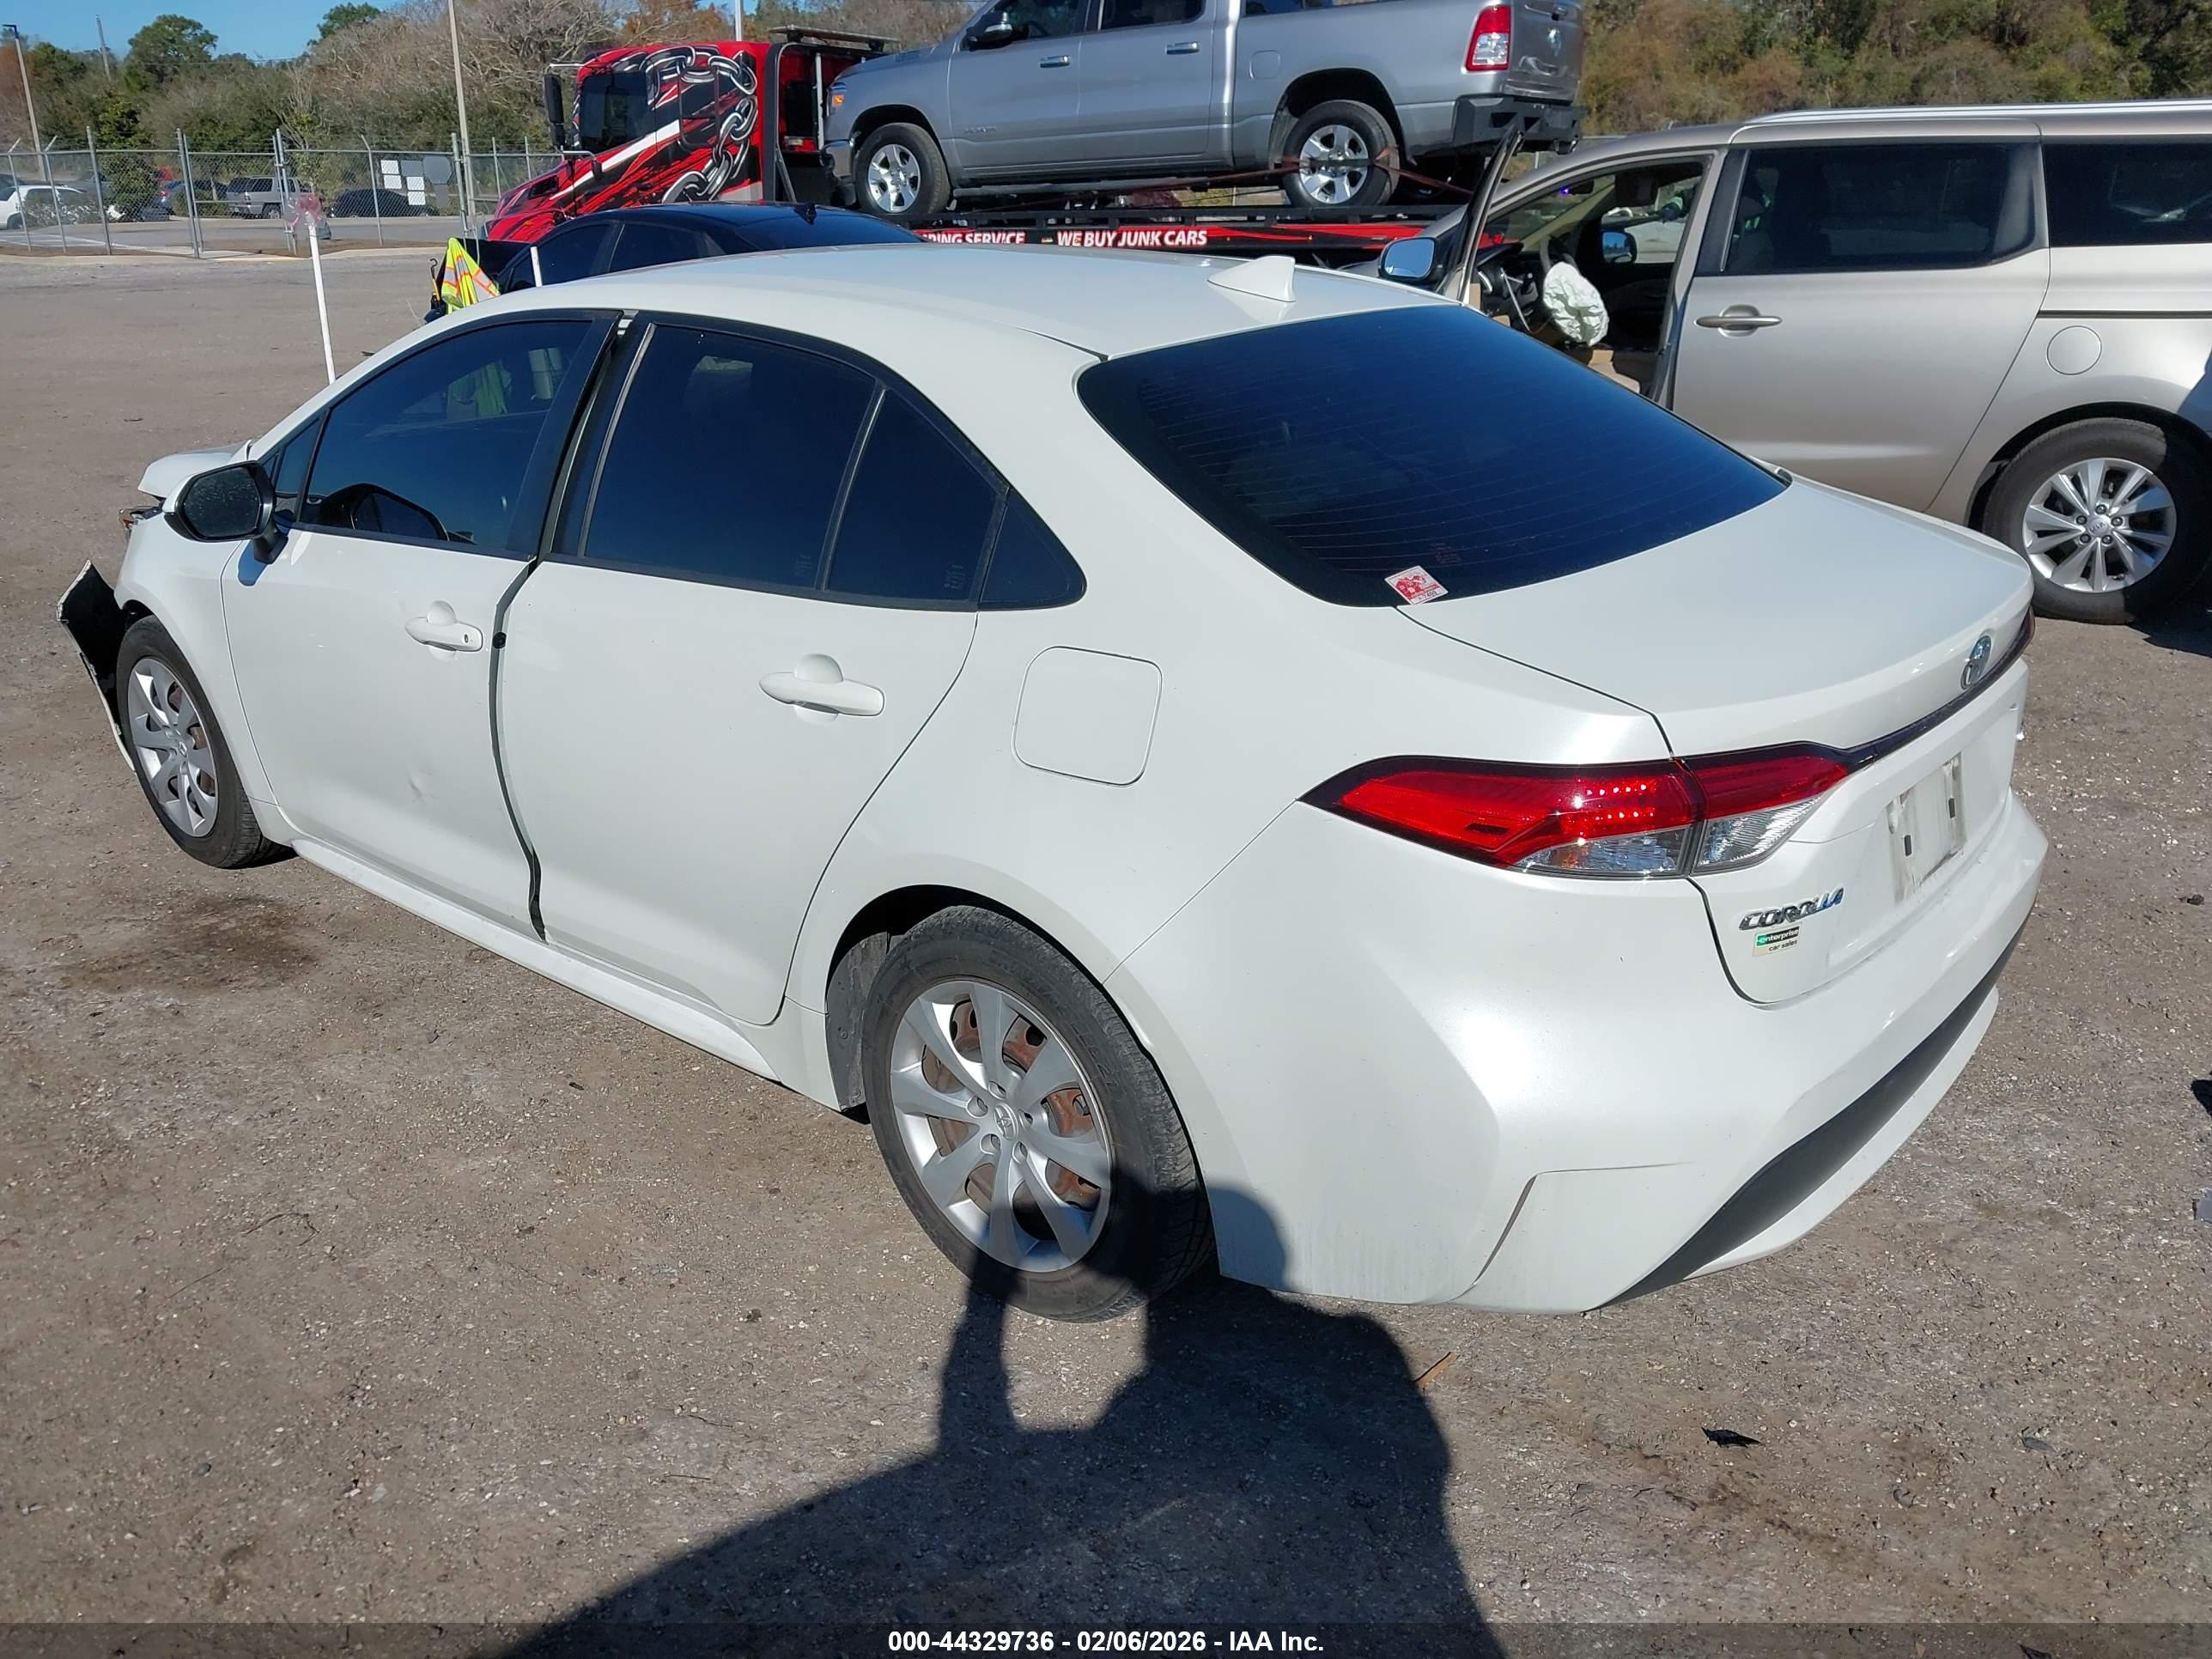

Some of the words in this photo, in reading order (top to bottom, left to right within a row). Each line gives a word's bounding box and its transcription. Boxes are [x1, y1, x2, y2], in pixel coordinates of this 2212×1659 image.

[922, 233, 963, 244] DING
[965, 232, 1025, 244] SERVICE
[1057, 231, 1082, 246] WE
[1084, 231, 1117, 247] BUY
[1117, 231, 1163, 246] JUNK
[1164, 230, 1207, 246] CARS
[1738, 887, 1844, 931] COROLLA
[1757, 928, 1800, 945] enterprise
[1781, 939, 1798, 949] sales
